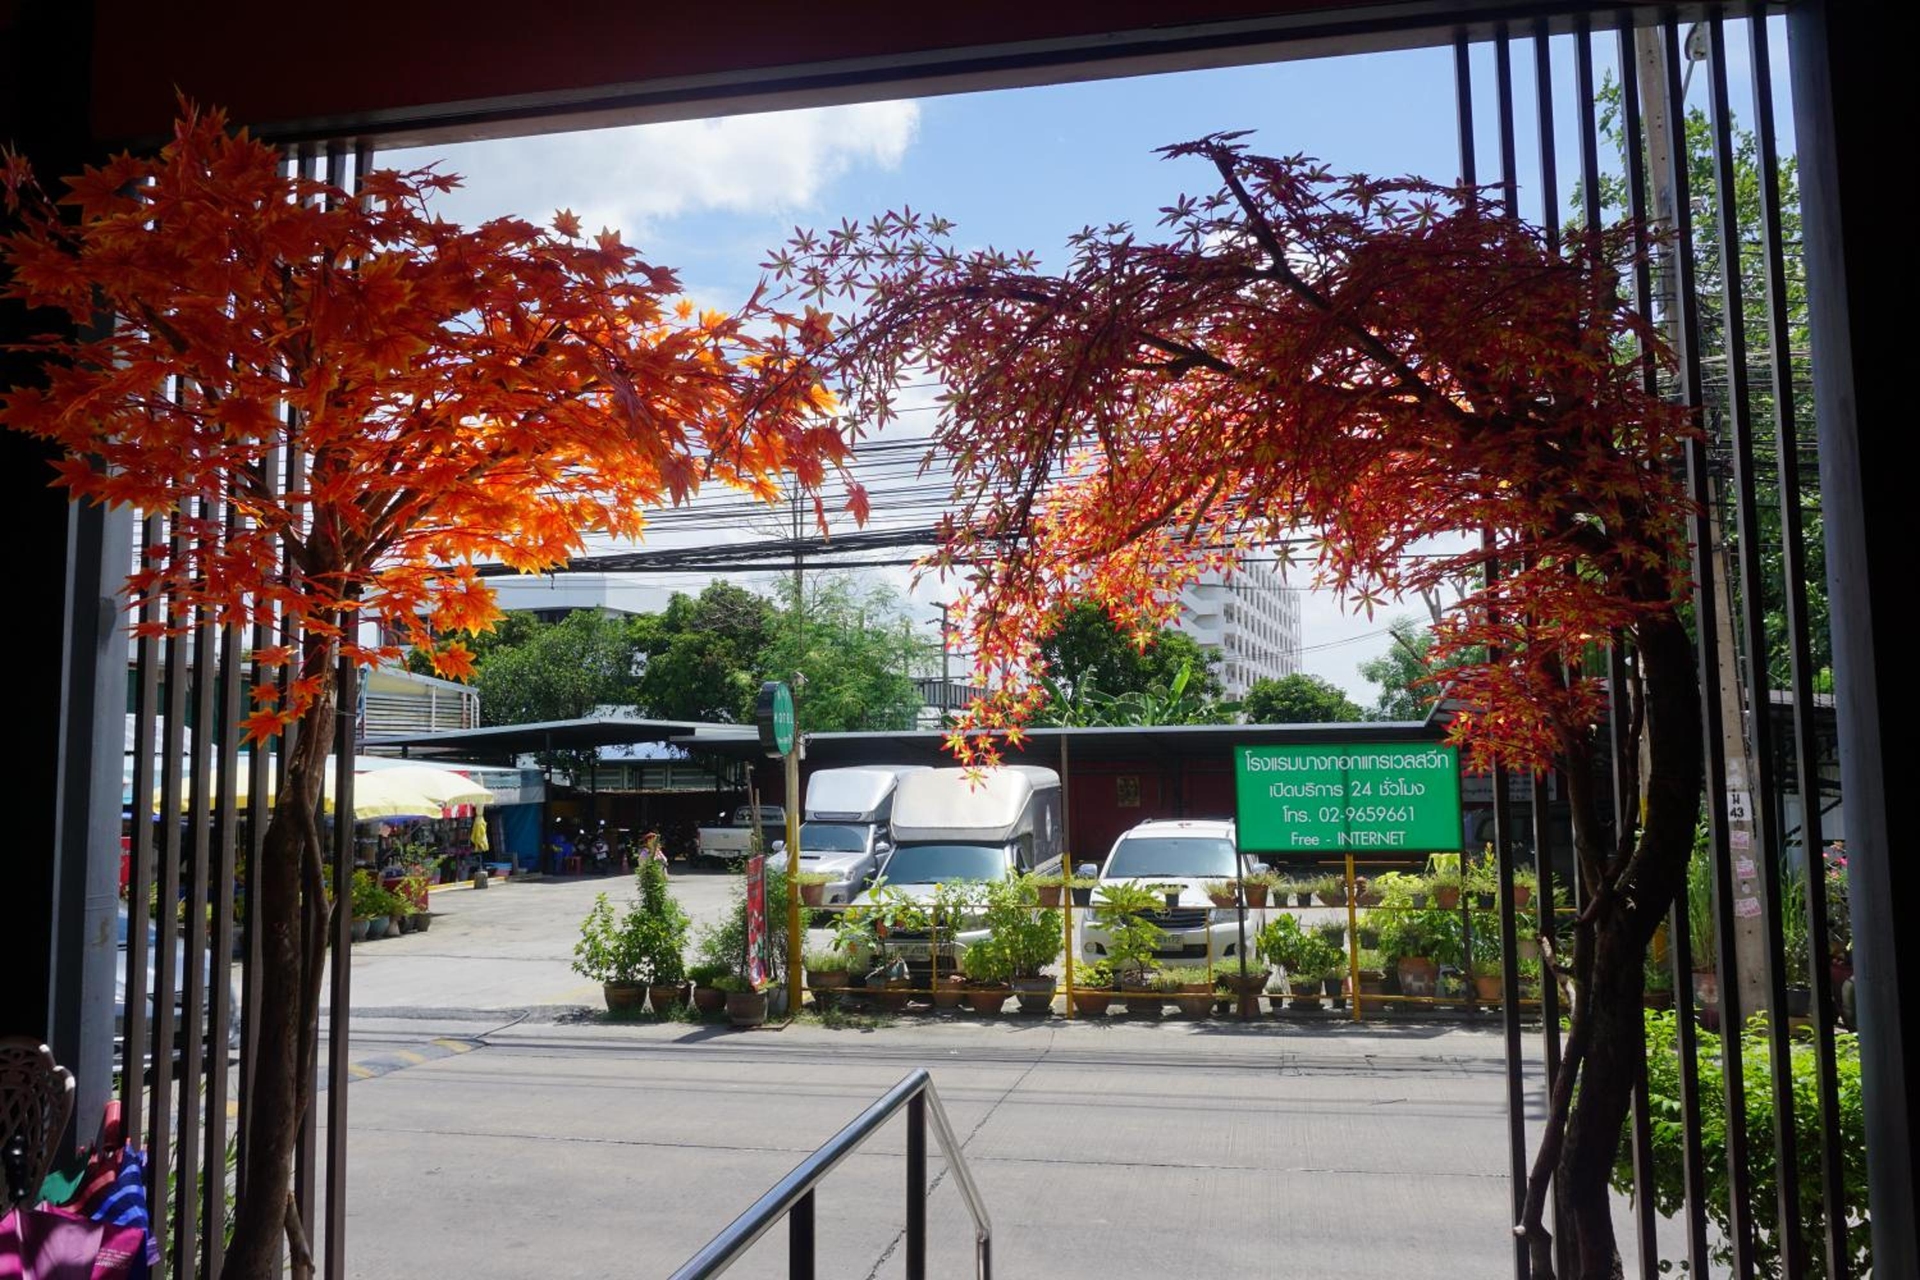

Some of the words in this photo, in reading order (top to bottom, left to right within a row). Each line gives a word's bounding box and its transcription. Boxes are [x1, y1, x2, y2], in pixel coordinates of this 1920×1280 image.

[1270, 783, 1343, 797] เปิดบริการ
[1352, 781, 1371, 796] 24
[1380, 778, 1424, 795] ชั่วโมง
[1283, 806, 1311, 822] โทร.
[1319, 807, 1413, 822] 02-9659661
[1730, 807, 1744, 819] 43
[1291, 832, 1319, 845] Free
[1337, 831, 1405, 845] INTERNET
